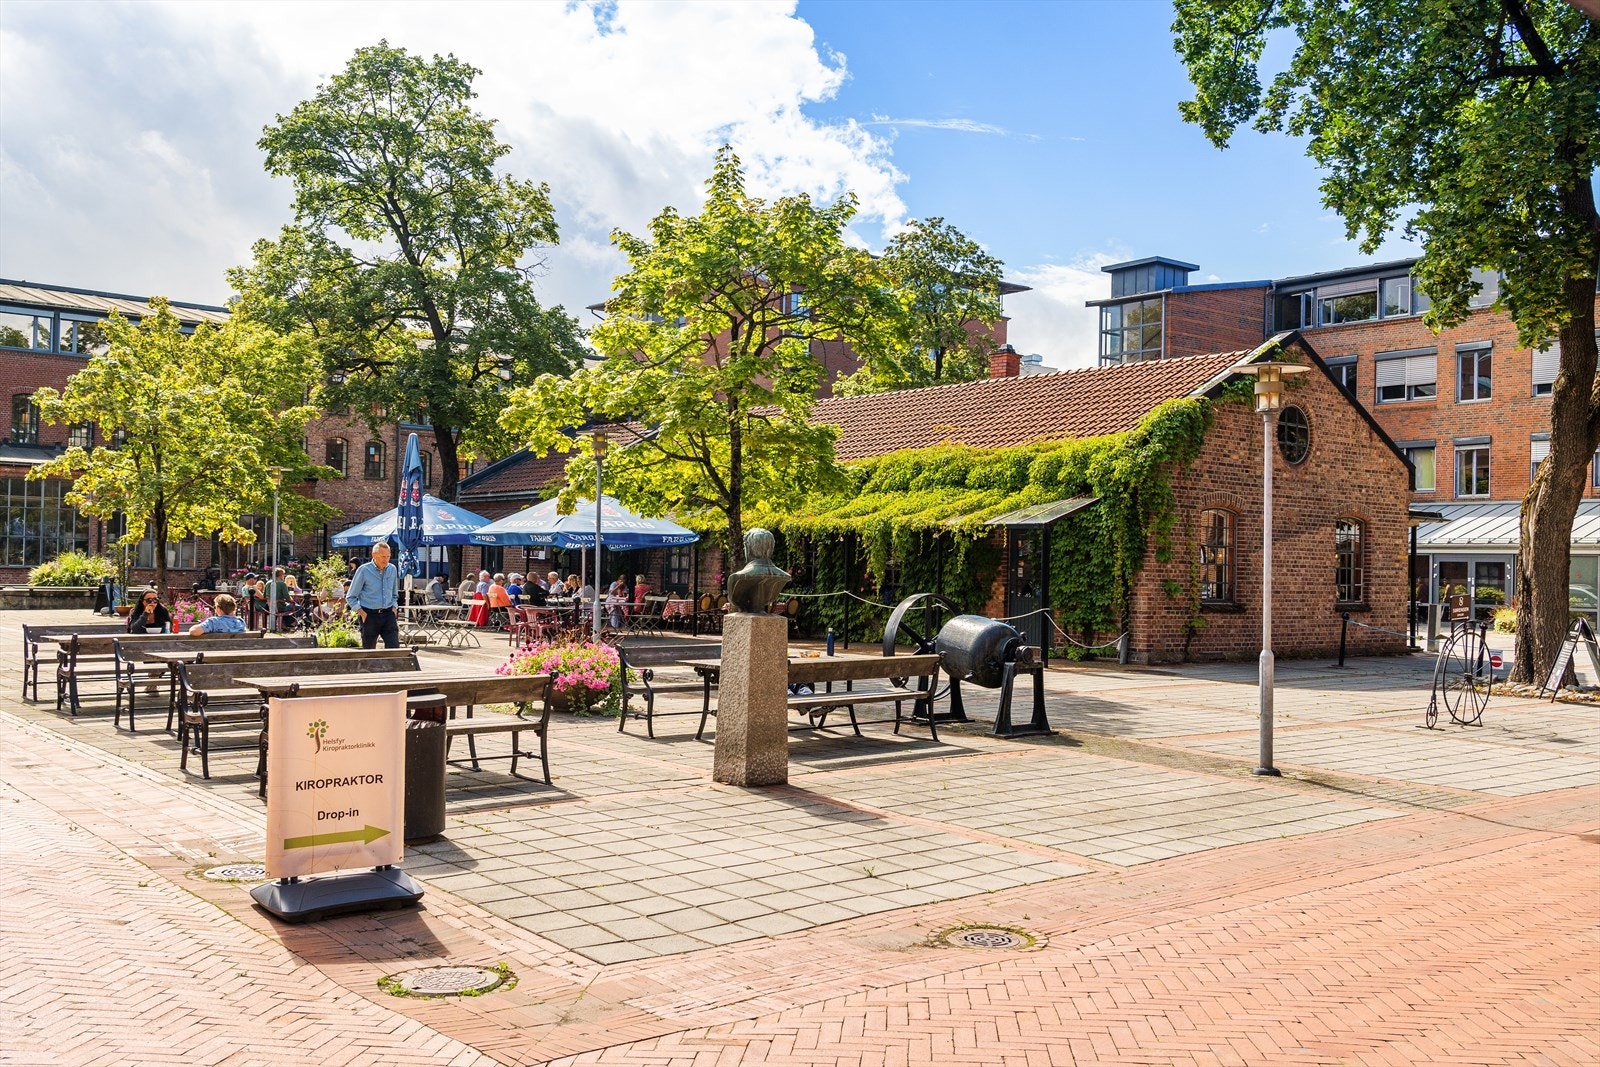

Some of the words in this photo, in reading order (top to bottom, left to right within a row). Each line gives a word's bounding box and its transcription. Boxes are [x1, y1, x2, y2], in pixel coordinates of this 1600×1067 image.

[322, 741, 376, 752] Kiropraktorklinikk
[295, 774, 384, 791] KIROPRAKTOR
[317, 807, 360, 821] Drop-in
